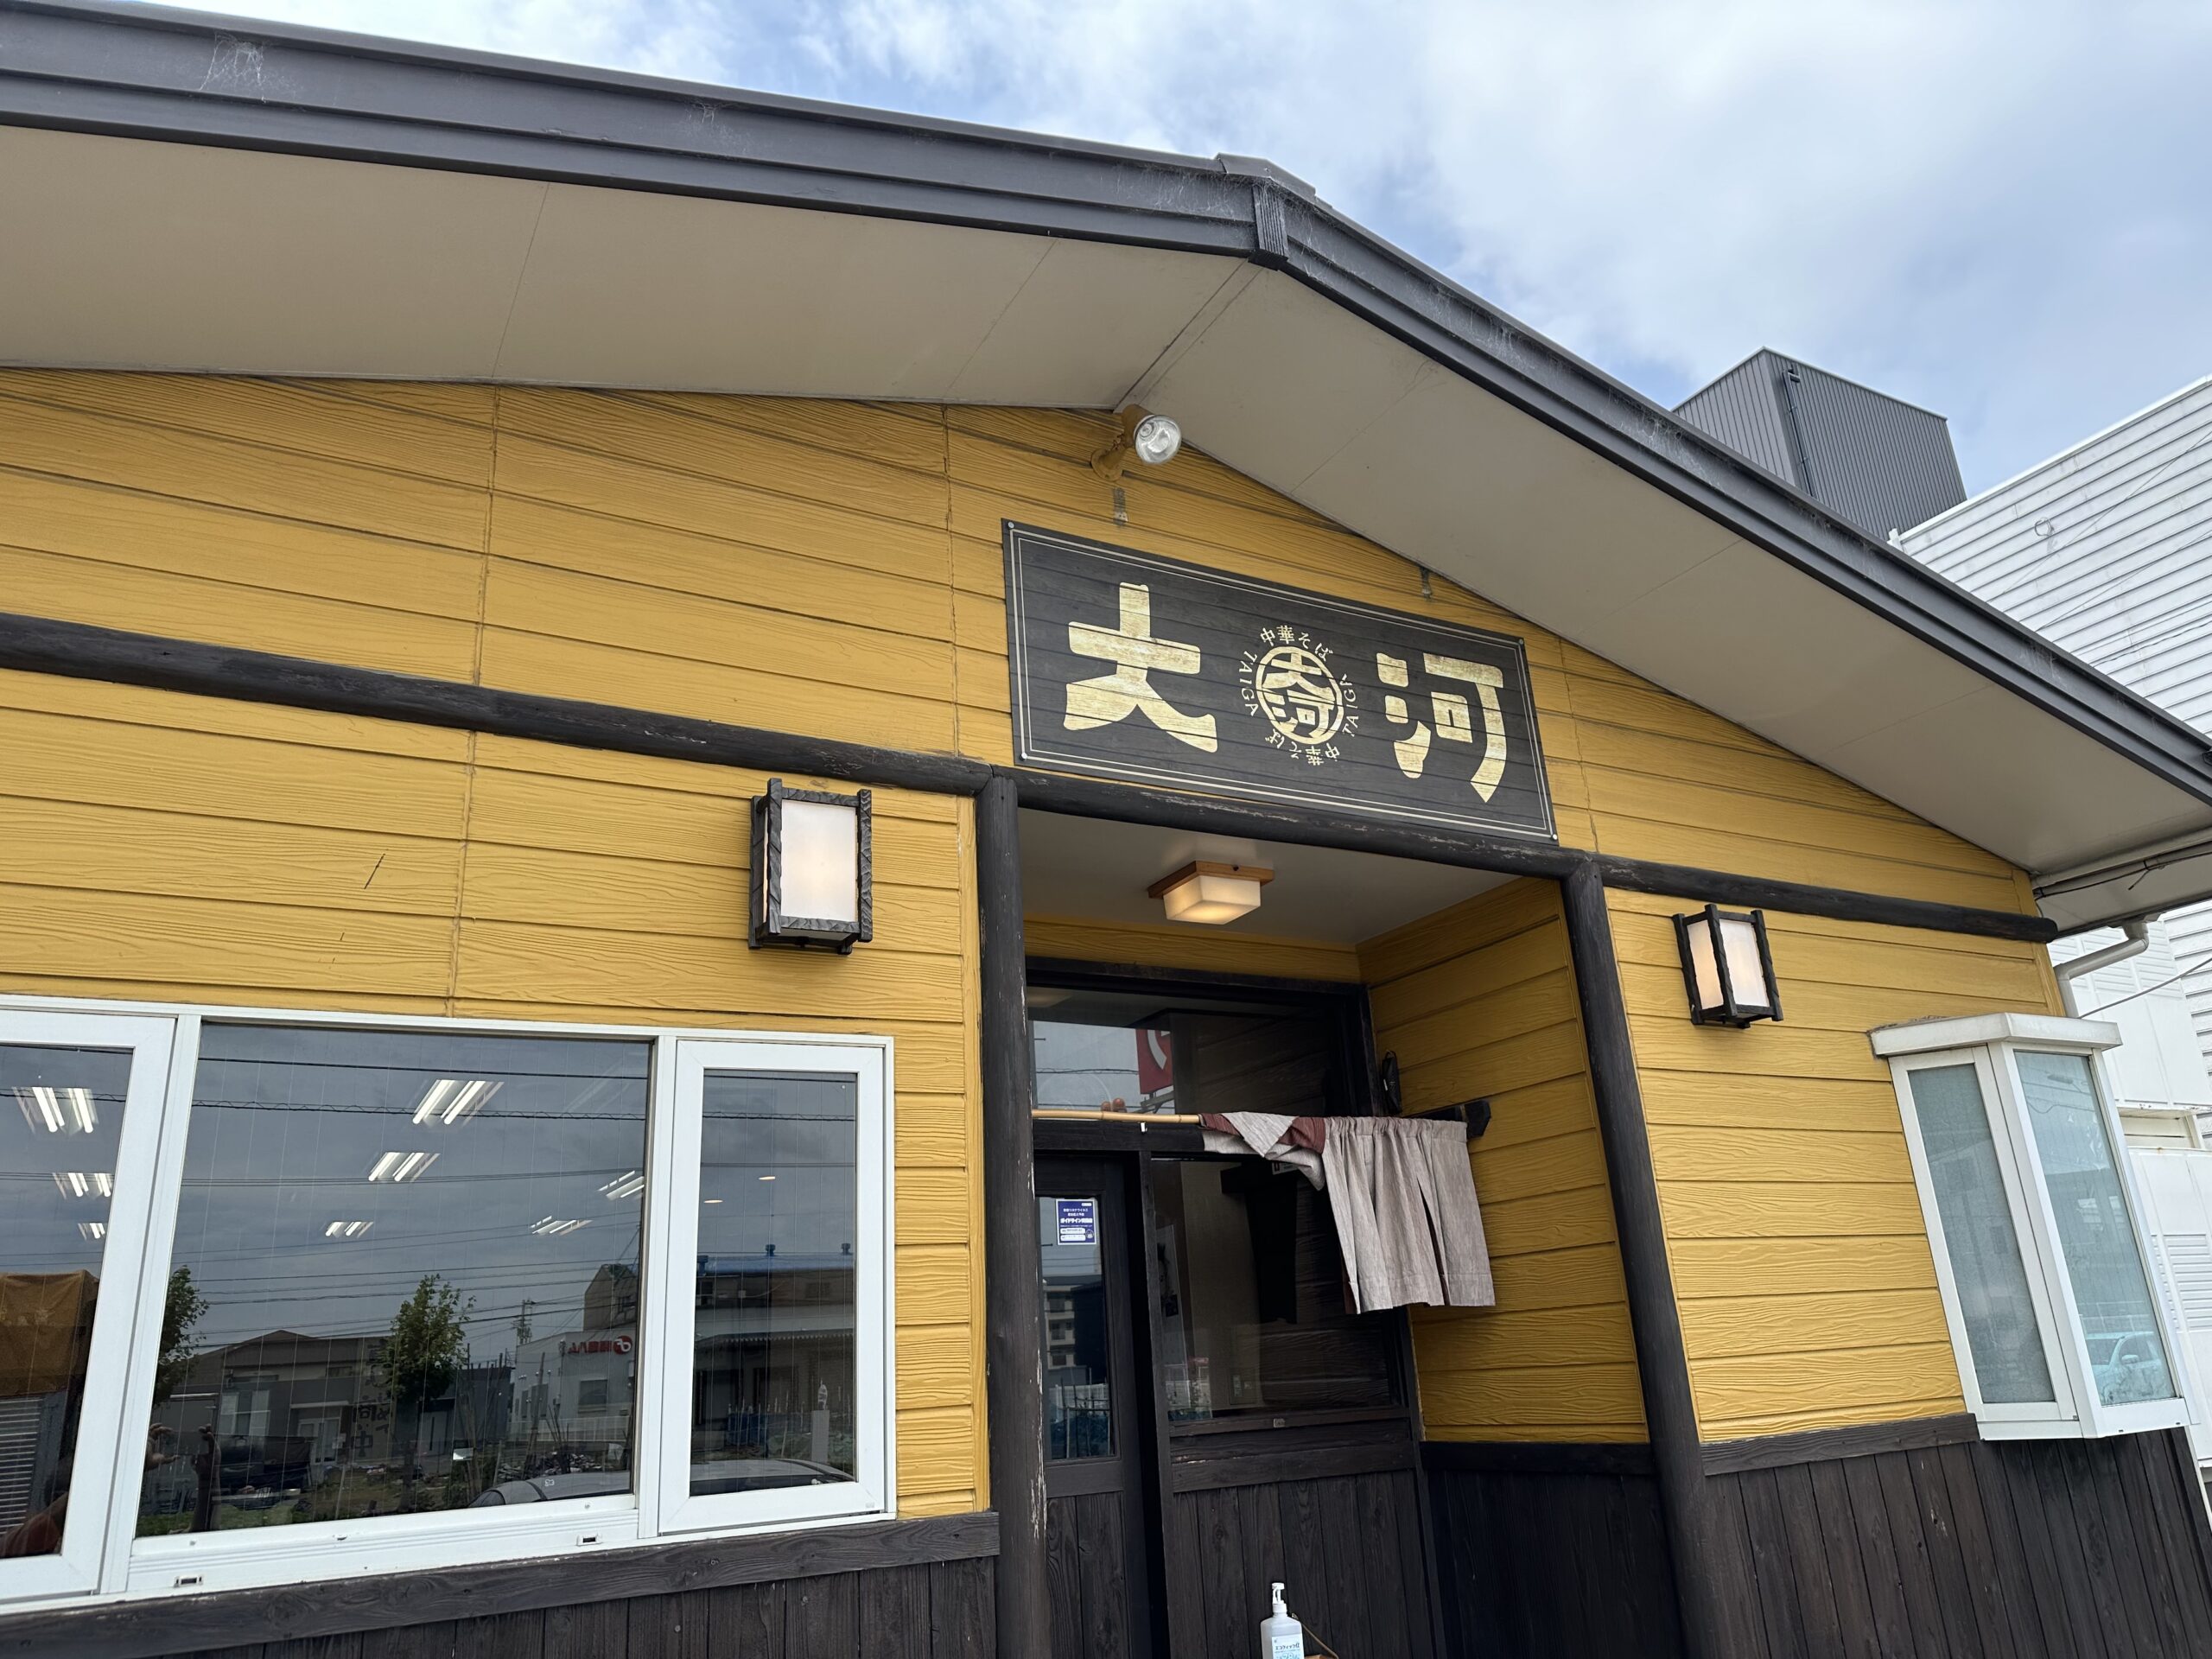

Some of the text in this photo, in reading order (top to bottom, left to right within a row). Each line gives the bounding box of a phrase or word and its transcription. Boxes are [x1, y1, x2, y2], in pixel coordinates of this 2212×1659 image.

[1261, 625, 1333, 662] 中華そば
[1064, 582, 1507, 803] 大 河
[1239, 651, 1259, 716] TAIGA
[1266, 729, 1340, 766] 中華そば
